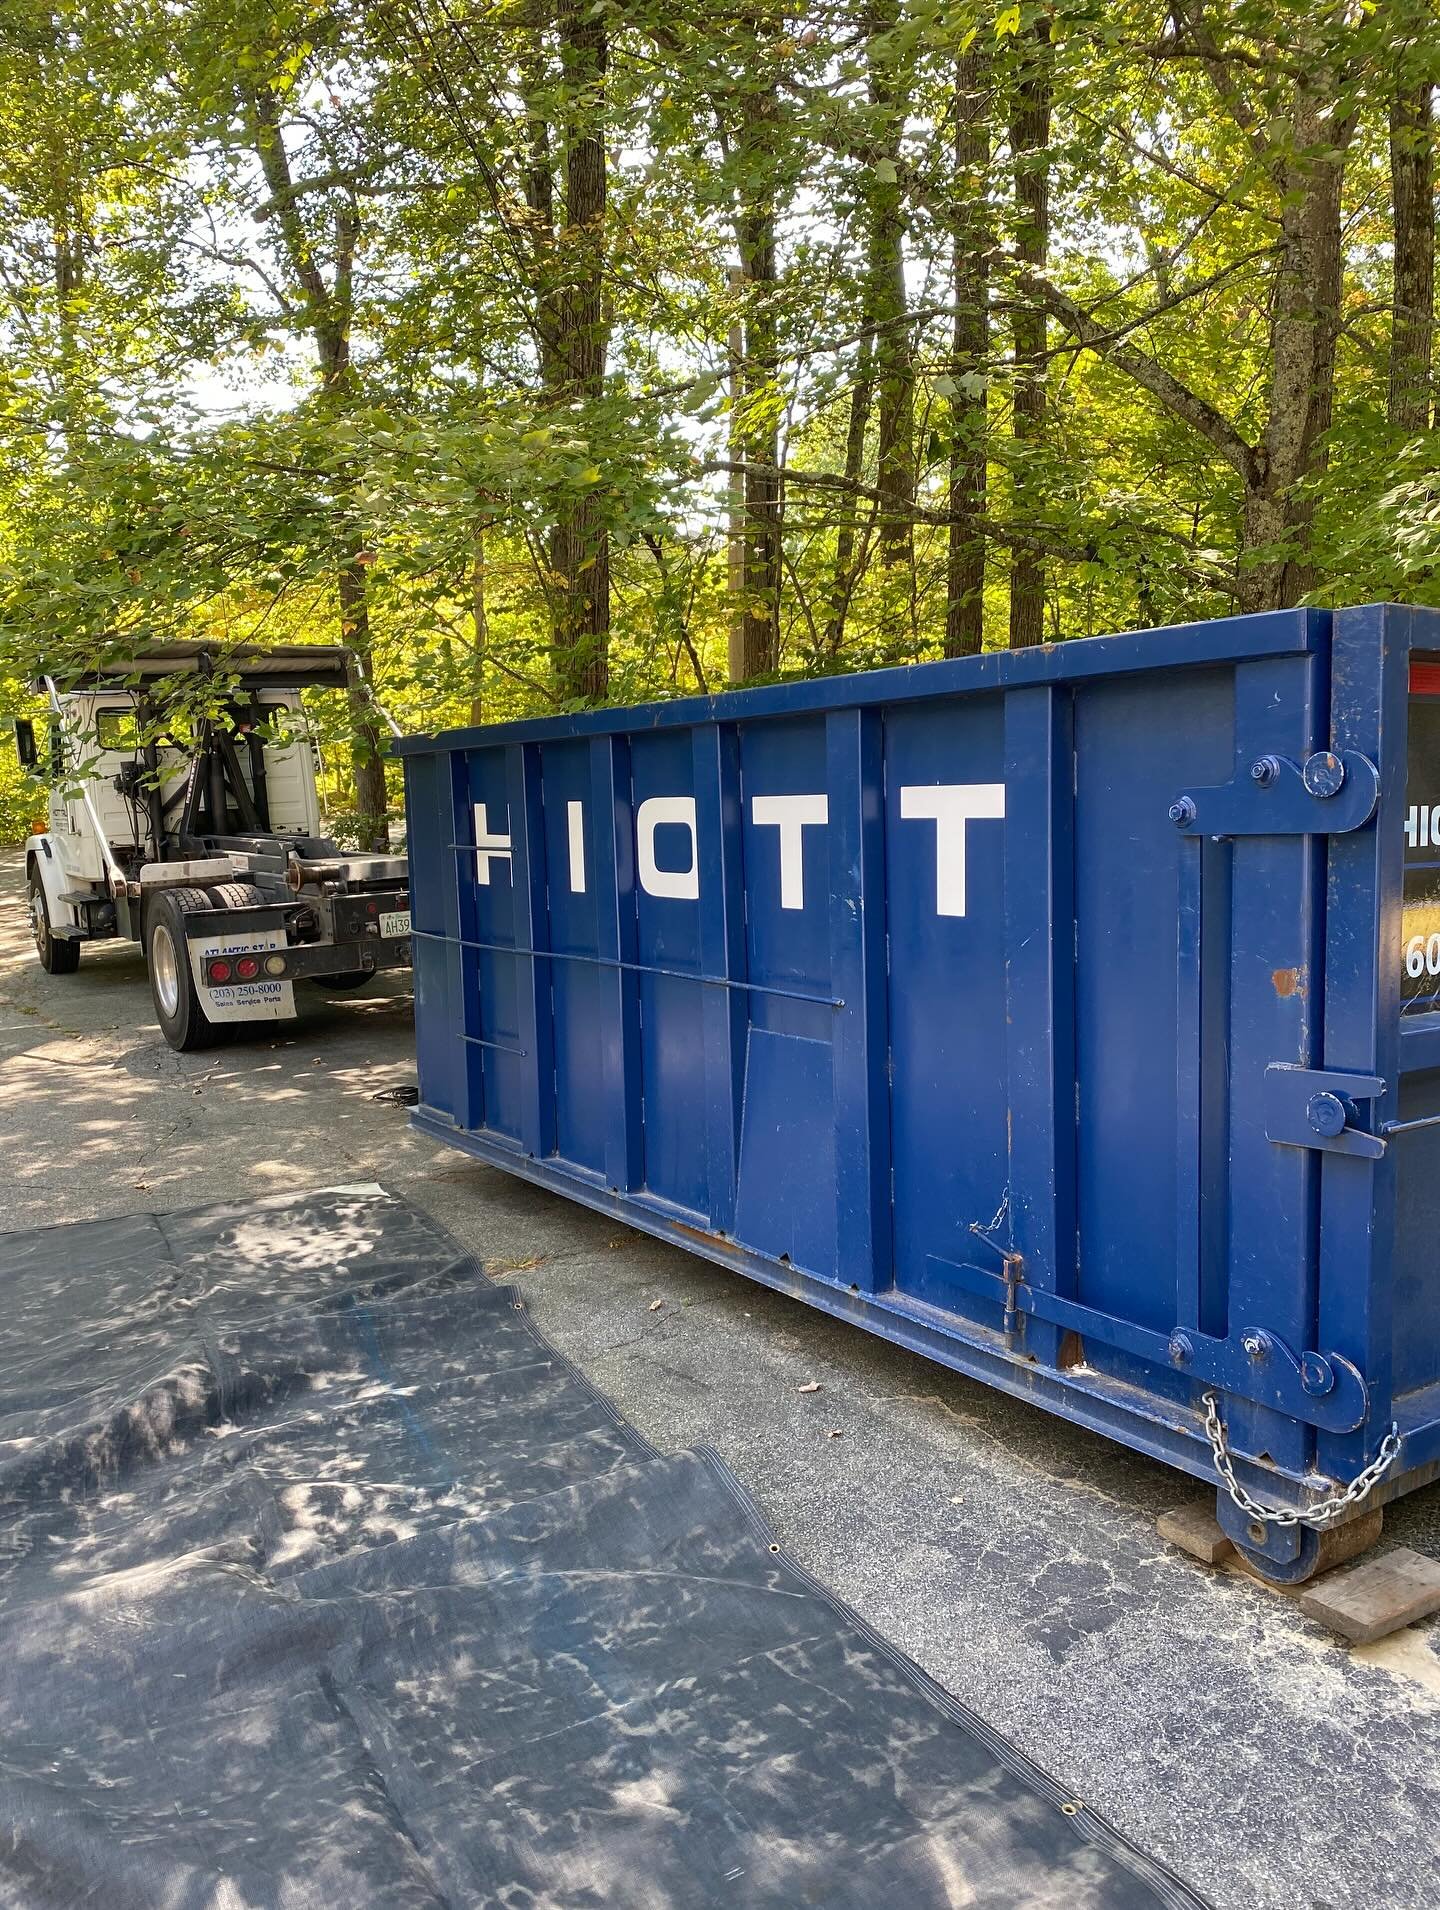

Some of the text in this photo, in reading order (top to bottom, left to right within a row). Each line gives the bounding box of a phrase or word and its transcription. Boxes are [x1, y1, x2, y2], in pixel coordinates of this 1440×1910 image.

[473, 783, 1006, 917] HIOTT
[209, 982, 282, 1001] (203) 250-8000
[236, 998, 261, 1006] Service
